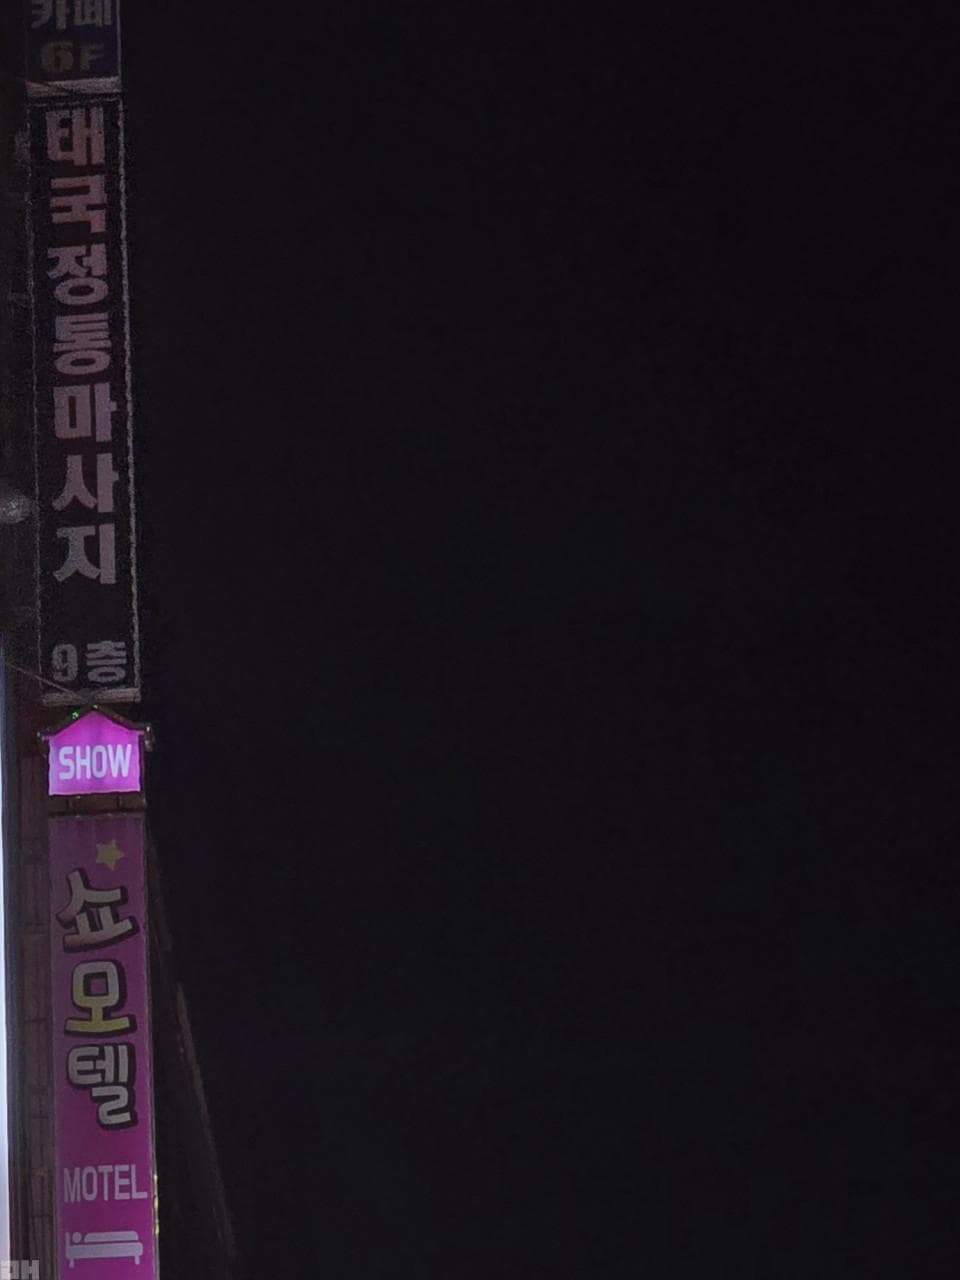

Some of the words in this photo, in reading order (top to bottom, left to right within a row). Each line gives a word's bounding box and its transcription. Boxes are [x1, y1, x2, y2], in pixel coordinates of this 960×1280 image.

[52, 641, 131, 684] 9층
[58, 744, 132, 781] SHOW
[56, 868, 138, 1131] 쇼모텔
[63, 1165, 147, 1203] MOTEL
